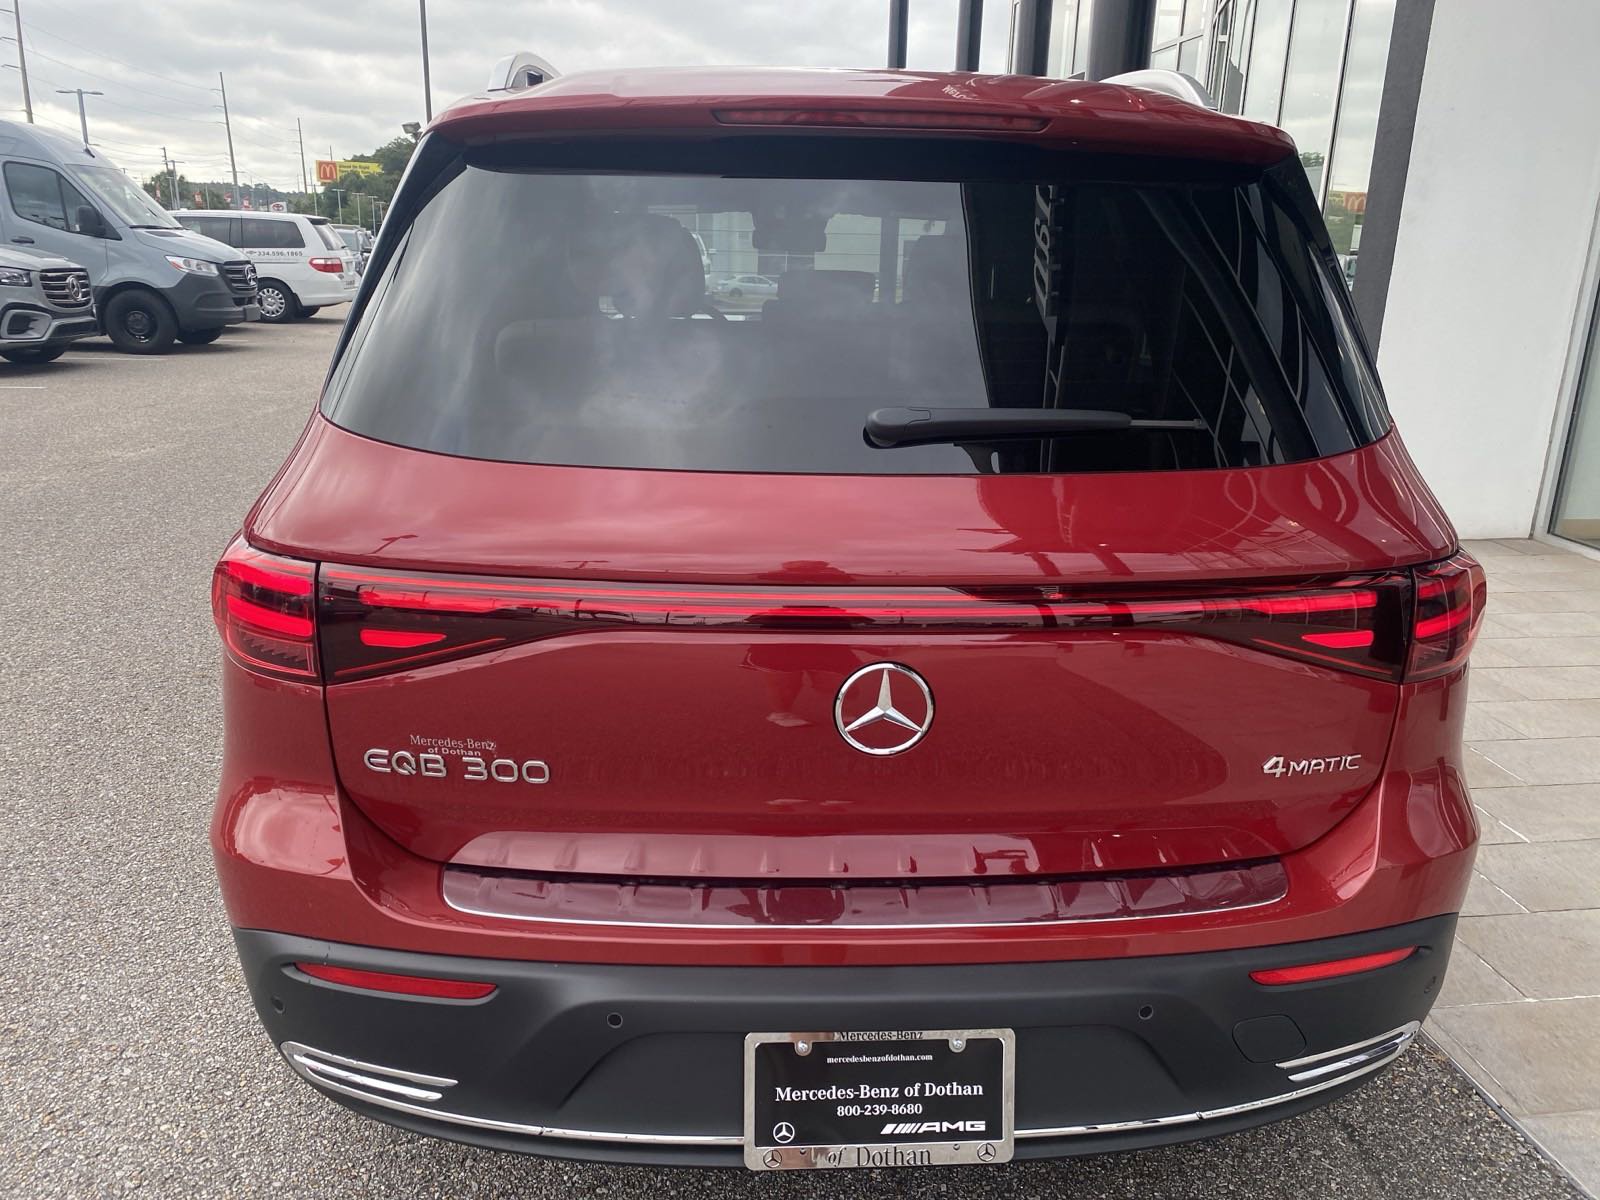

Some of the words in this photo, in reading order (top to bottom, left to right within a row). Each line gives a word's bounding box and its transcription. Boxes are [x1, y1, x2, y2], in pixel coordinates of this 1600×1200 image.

[410, 734, 496, 751] Mercedes-Benz
[441, 747, 481, 756] Dothan
[363, 748, 447, 778] EQB
[462, 756, 550, 785] 300
[1263, 755, 1361, 778] 4MATIC
[840, 1030, 923, 1041] Mercedes-Benz
[826, 1053, 933, 1064] mercedesbenzofdothan.com
[775, 1084, 899, 1102] Mercedes-Benz
[904, 1082, 921, 1097] of
[924, 1081, 984, 1097] Dothan
[836, 1103, 923, 1117] 800-239-8680
[917, 1120, 986, 1132] AMG
[827, 1147, 847, 1168] of
[856, 1144, 933, 1167] Dothan
